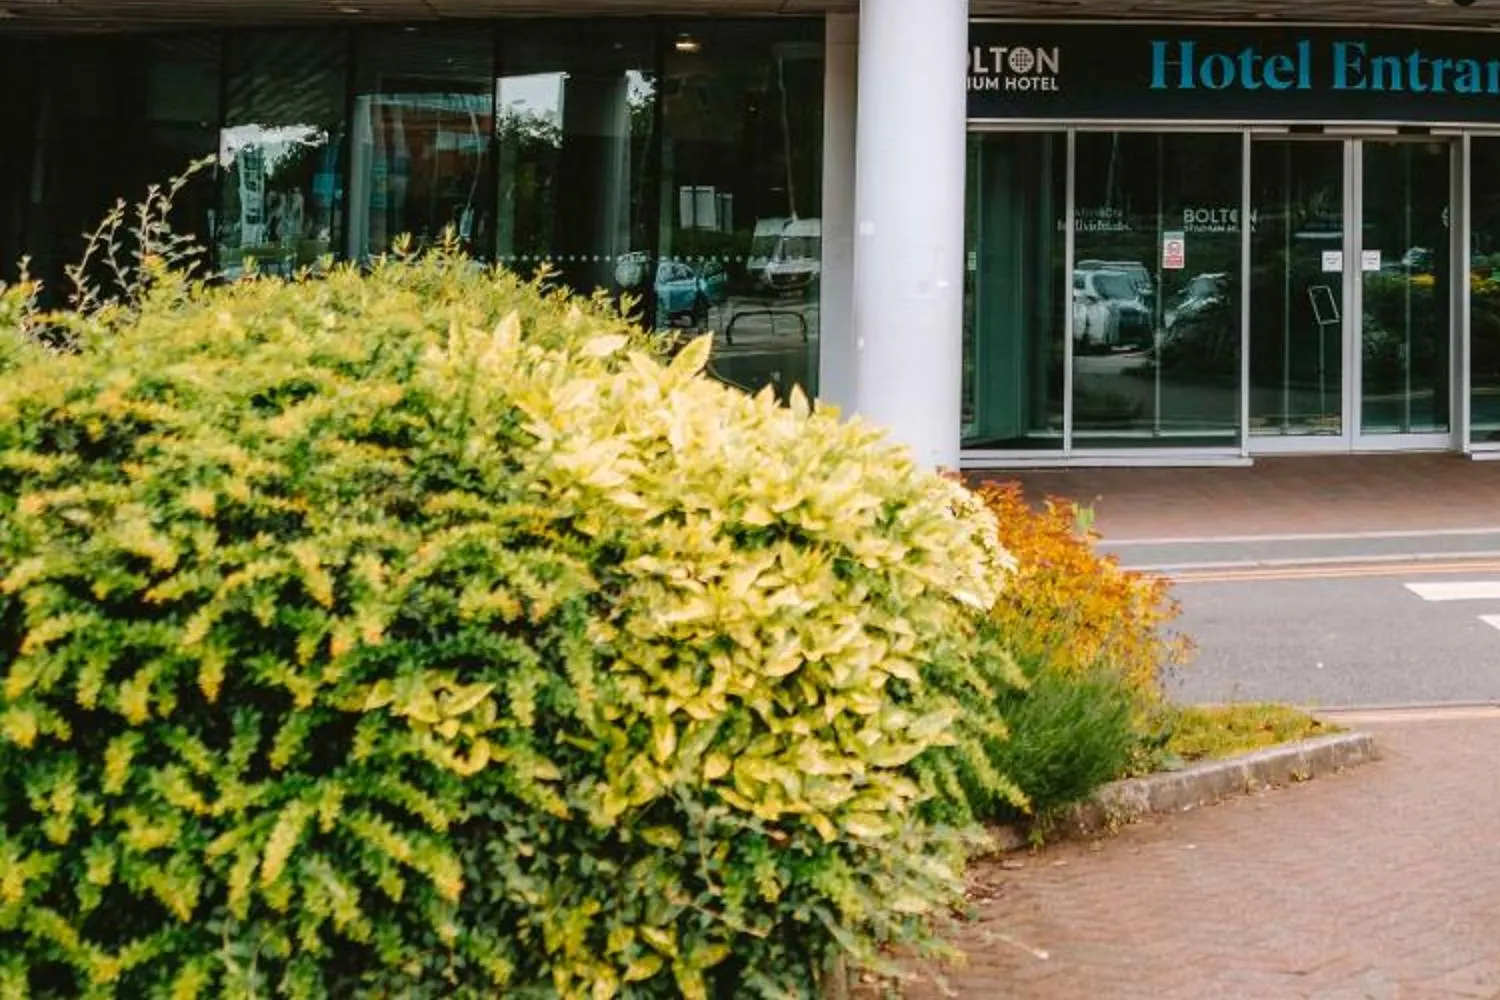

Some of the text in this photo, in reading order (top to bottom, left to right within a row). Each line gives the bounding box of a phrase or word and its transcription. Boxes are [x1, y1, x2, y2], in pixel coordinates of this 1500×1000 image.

[966, 46, 1059, 74] LTON
[1150, 40, 1311, 90] Hotel
[1005, 76, 1059, 91] HOTEL
